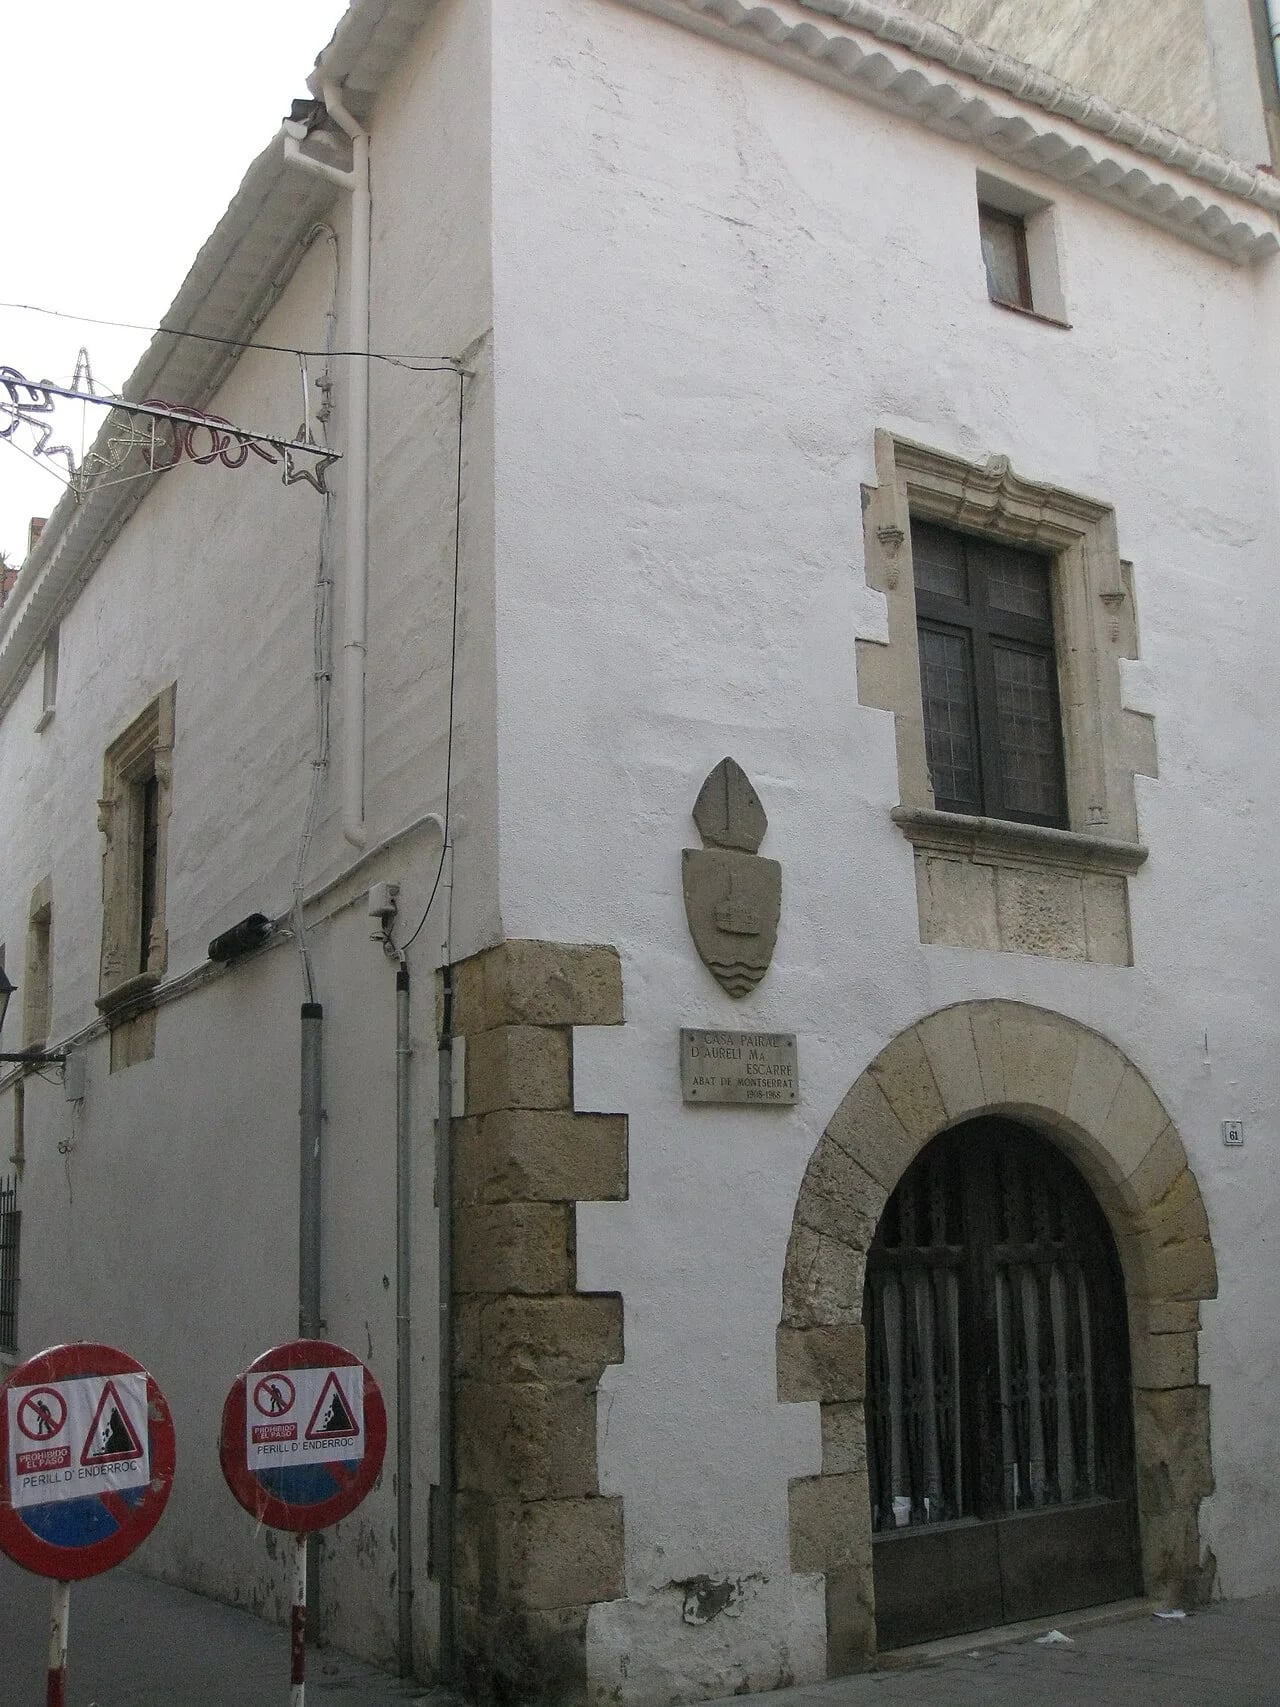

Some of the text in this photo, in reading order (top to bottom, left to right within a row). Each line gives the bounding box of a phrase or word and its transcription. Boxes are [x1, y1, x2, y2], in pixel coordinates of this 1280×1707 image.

[703, 1032, 734, 1046] CASA
[692, 1076, 793, 1088] ABAT DE MONTSERRAT
[1229, 1130, 1238, 1140] 61
[254, 1424, 295, 1434] PROHIBIDO
[260, 1430, 292, 1440] EL PASO
[257, 1442, 289, 1455] PERILL
[302, 1437, 354, 1450] ENDERROC
[20, 1448, 68, 1462] PROHIBIDO
[26, 1457, 64, 1469] EL PASO
[23, 1473, 62, 1487] PERILL
[78, 1460, 138, 1479] ENDERROC
